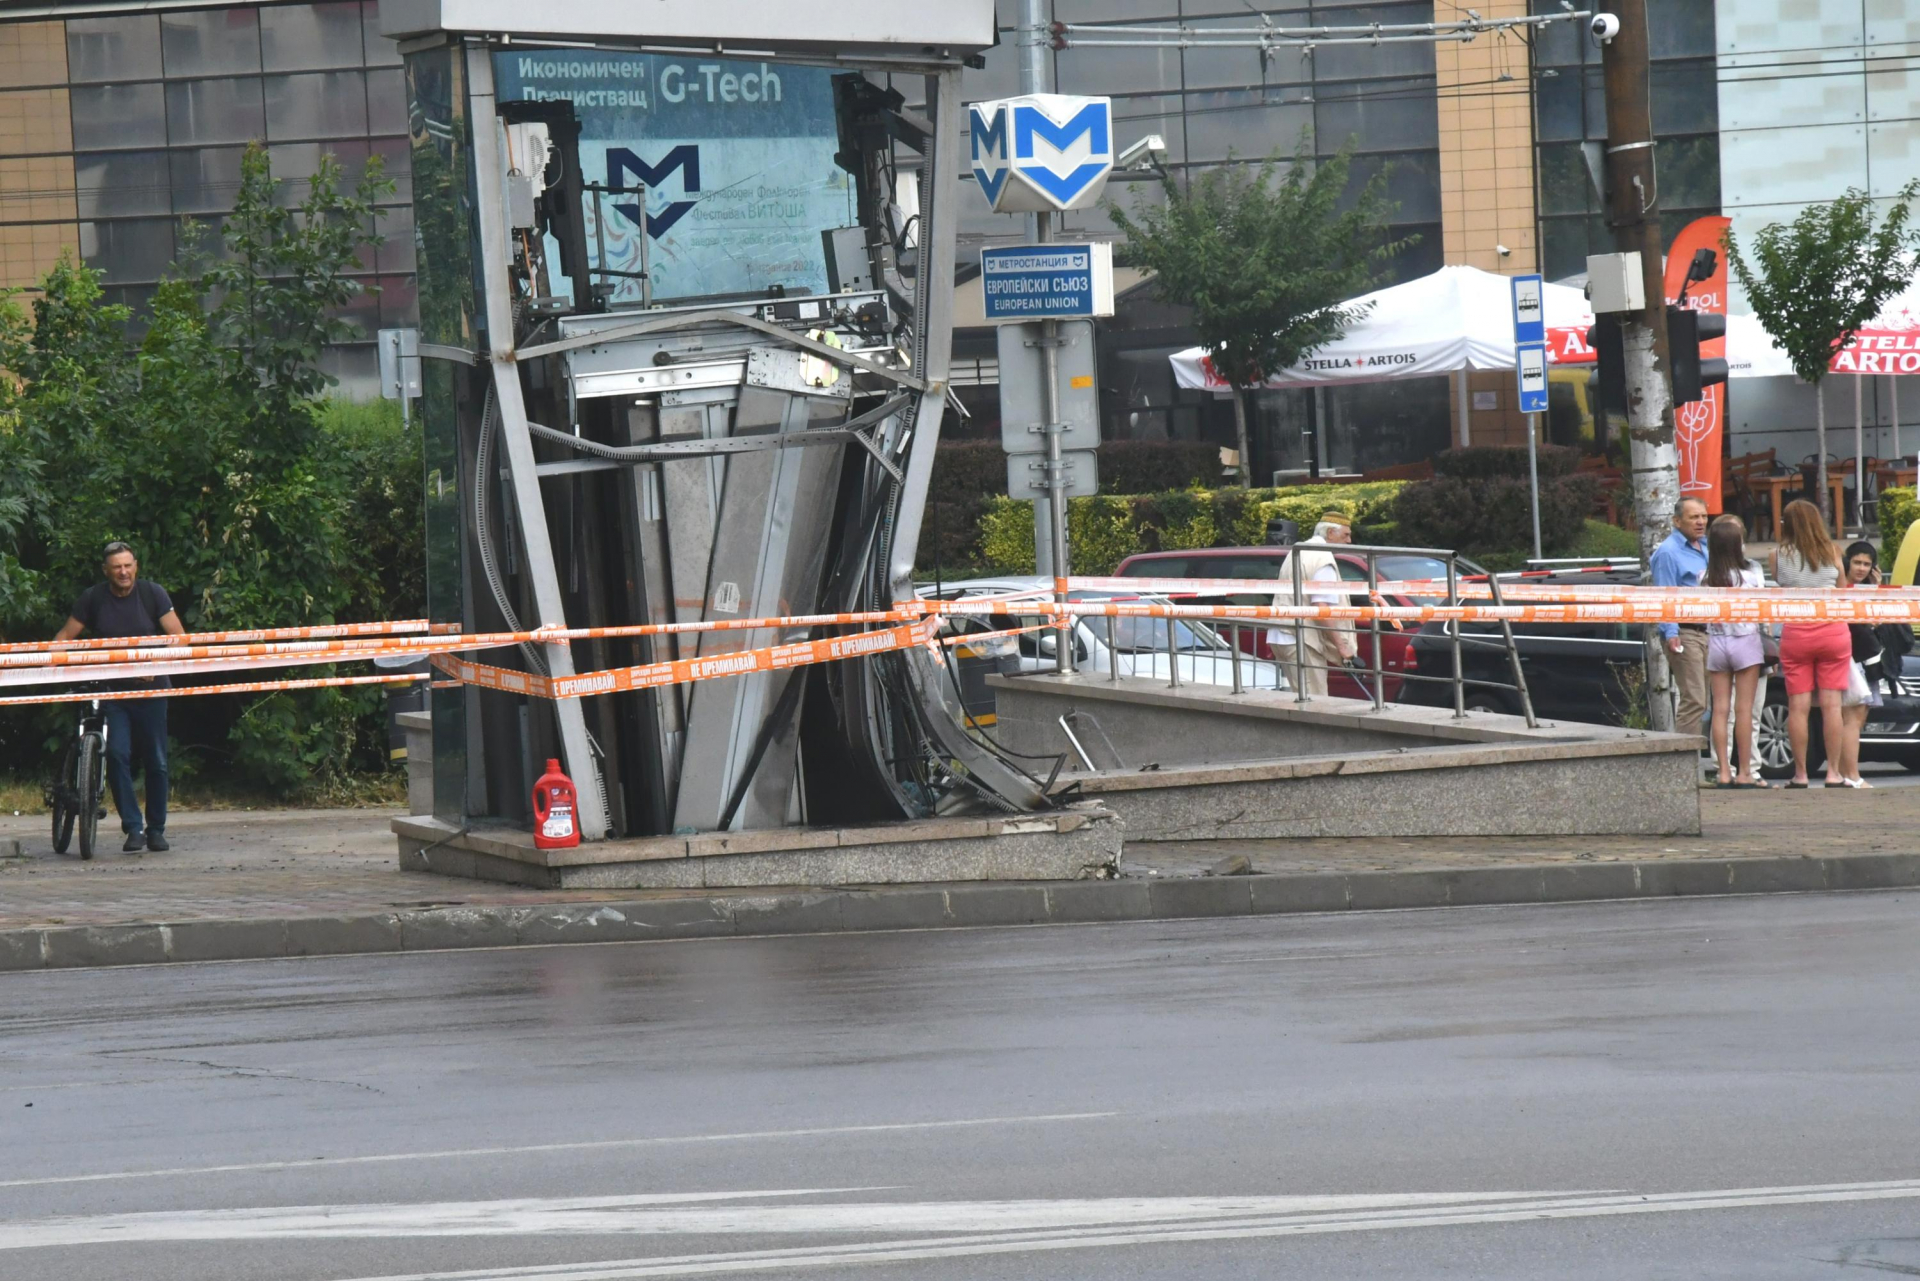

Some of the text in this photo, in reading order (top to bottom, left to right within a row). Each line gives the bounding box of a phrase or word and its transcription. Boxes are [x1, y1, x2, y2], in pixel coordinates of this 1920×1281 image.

[518, 58, 644, 79] Икономичен
[660, 62, 782, 103] G-Tech
[748, 203, 807, 219] ВИТОША
[793, 261, 815, 272] 2022
[999, 257, 1068, 269] МЕТРОСТАНЦИЯ
[987, 276, 1088, 295] ЕВРОПЕЙСКИ СЪЮЗ
[994, 296, 1079, 310] EUROPEAN UNION
[1304, 353, 1416, 371] STELLA ARTOIS
[842, 631, 897, 655] ПРЕМИНАВАЙ!
[690, 653, 757, 677] НЕ ПРЕМИНАВАЙ!
[560, 673, 616, 695] ПРЕМИНАВАЙ!
